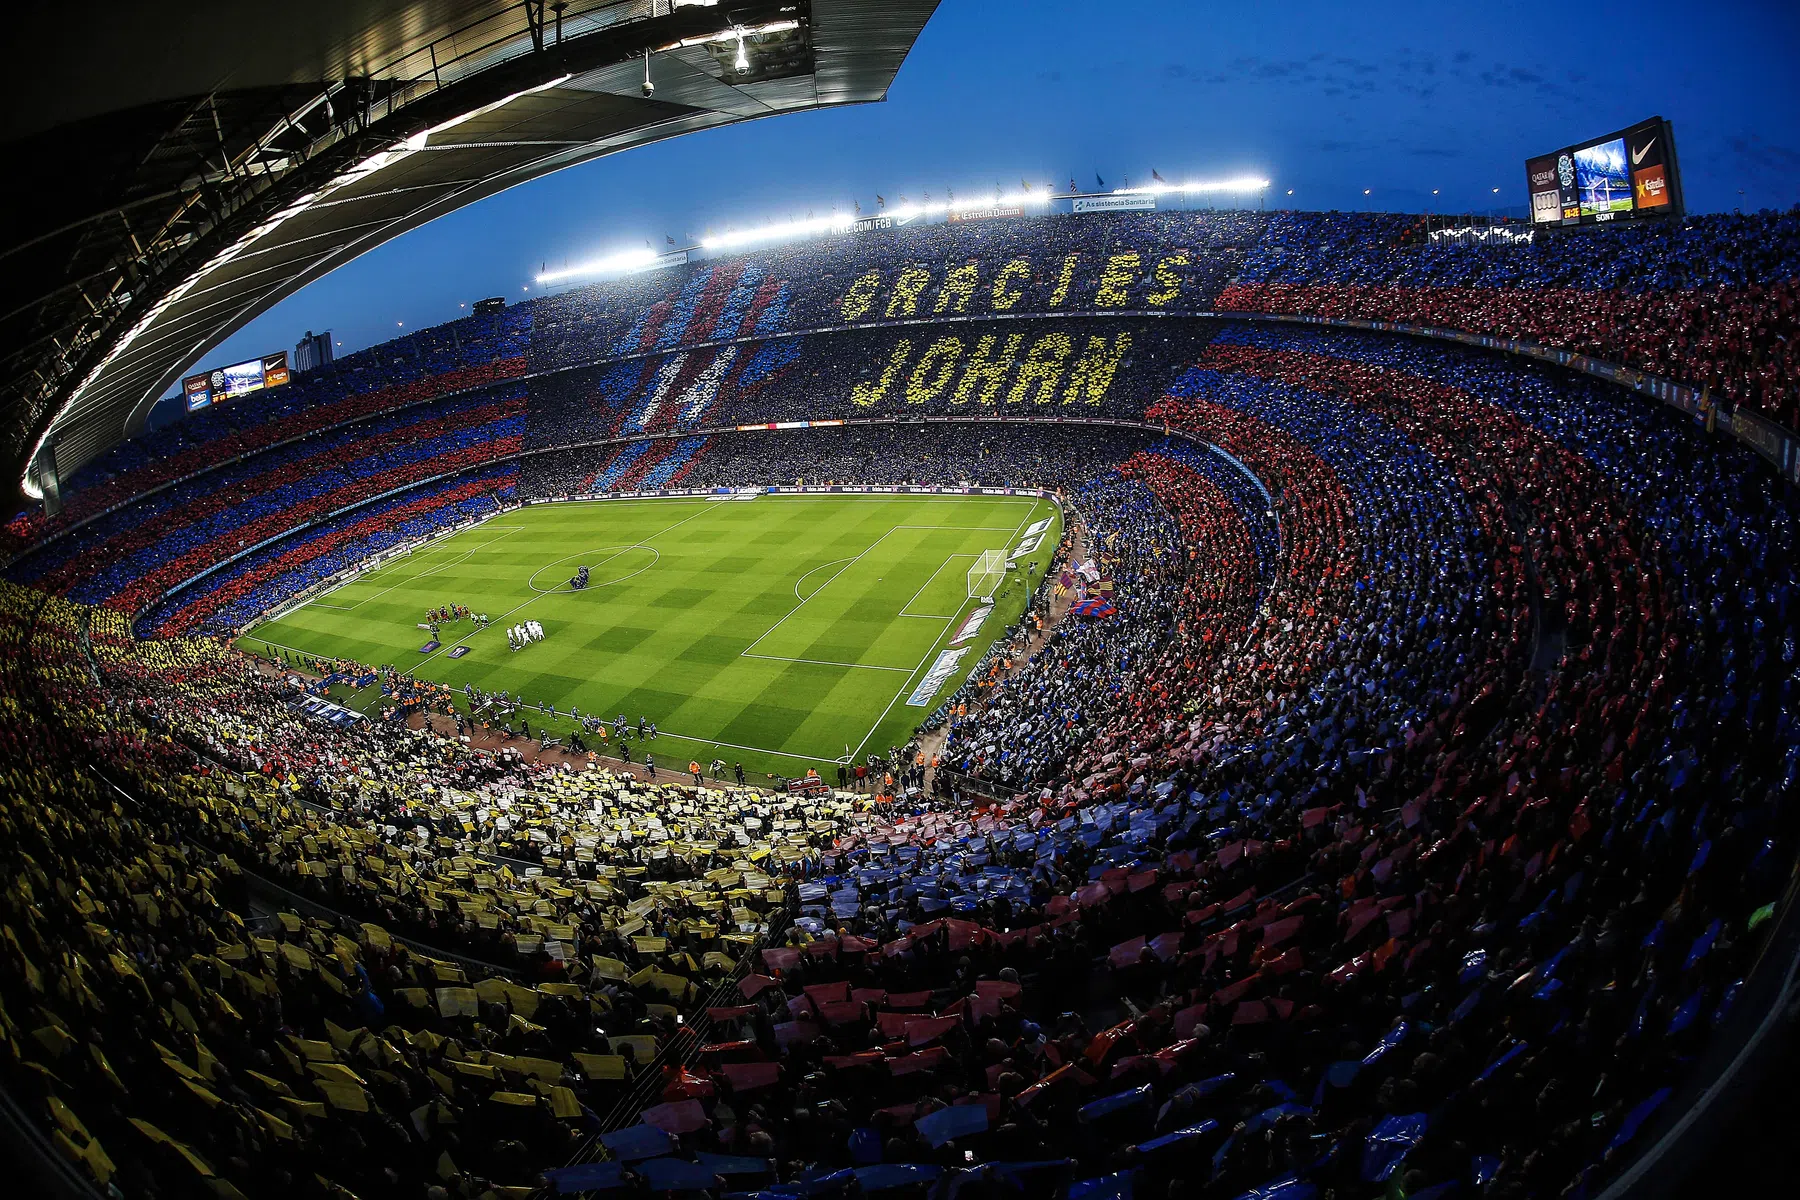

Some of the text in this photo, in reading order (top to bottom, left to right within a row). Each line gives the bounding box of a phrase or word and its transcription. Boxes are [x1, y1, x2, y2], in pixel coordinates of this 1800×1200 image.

[961, 208, 1020, 220] Estrella Damm
[1596, 213, 1615, 222] SONY
[851, 331, 1132, 407] JOHAN
